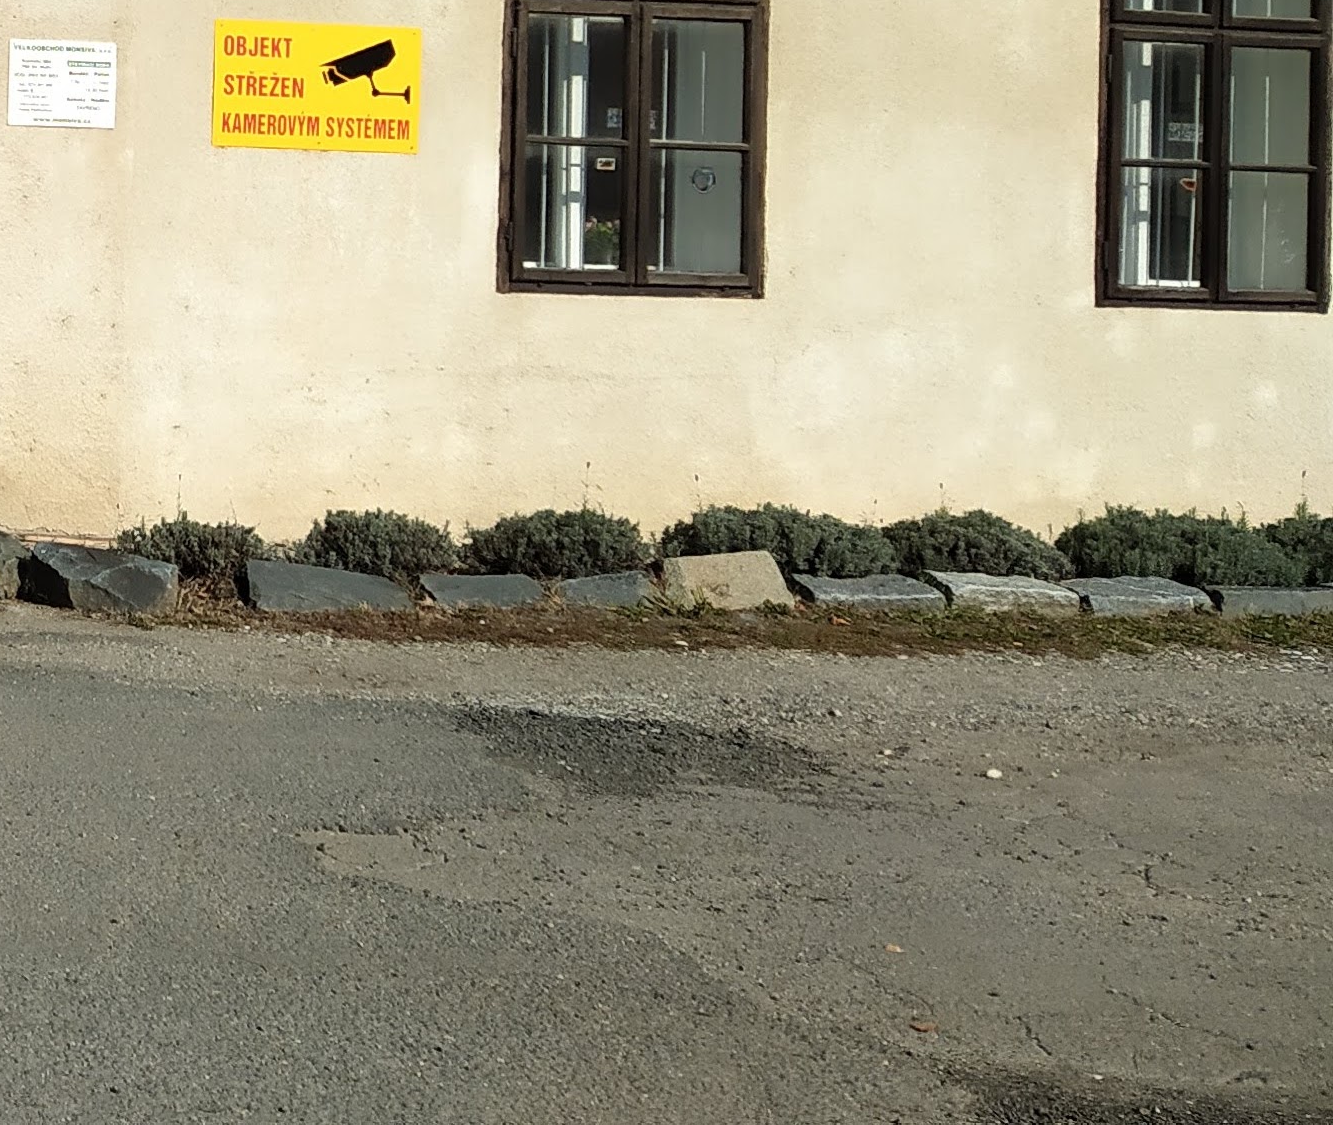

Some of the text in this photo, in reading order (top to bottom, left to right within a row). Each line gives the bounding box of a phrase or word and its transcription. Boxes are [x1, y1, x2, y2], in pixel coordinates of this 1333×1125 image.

[224, 35, 293, 59] OBJEKT
[223, 70, 305, 99] STŘEŽEN
[221, 111, 411, 141] KAMEROVÝM SYSTÉMEM
